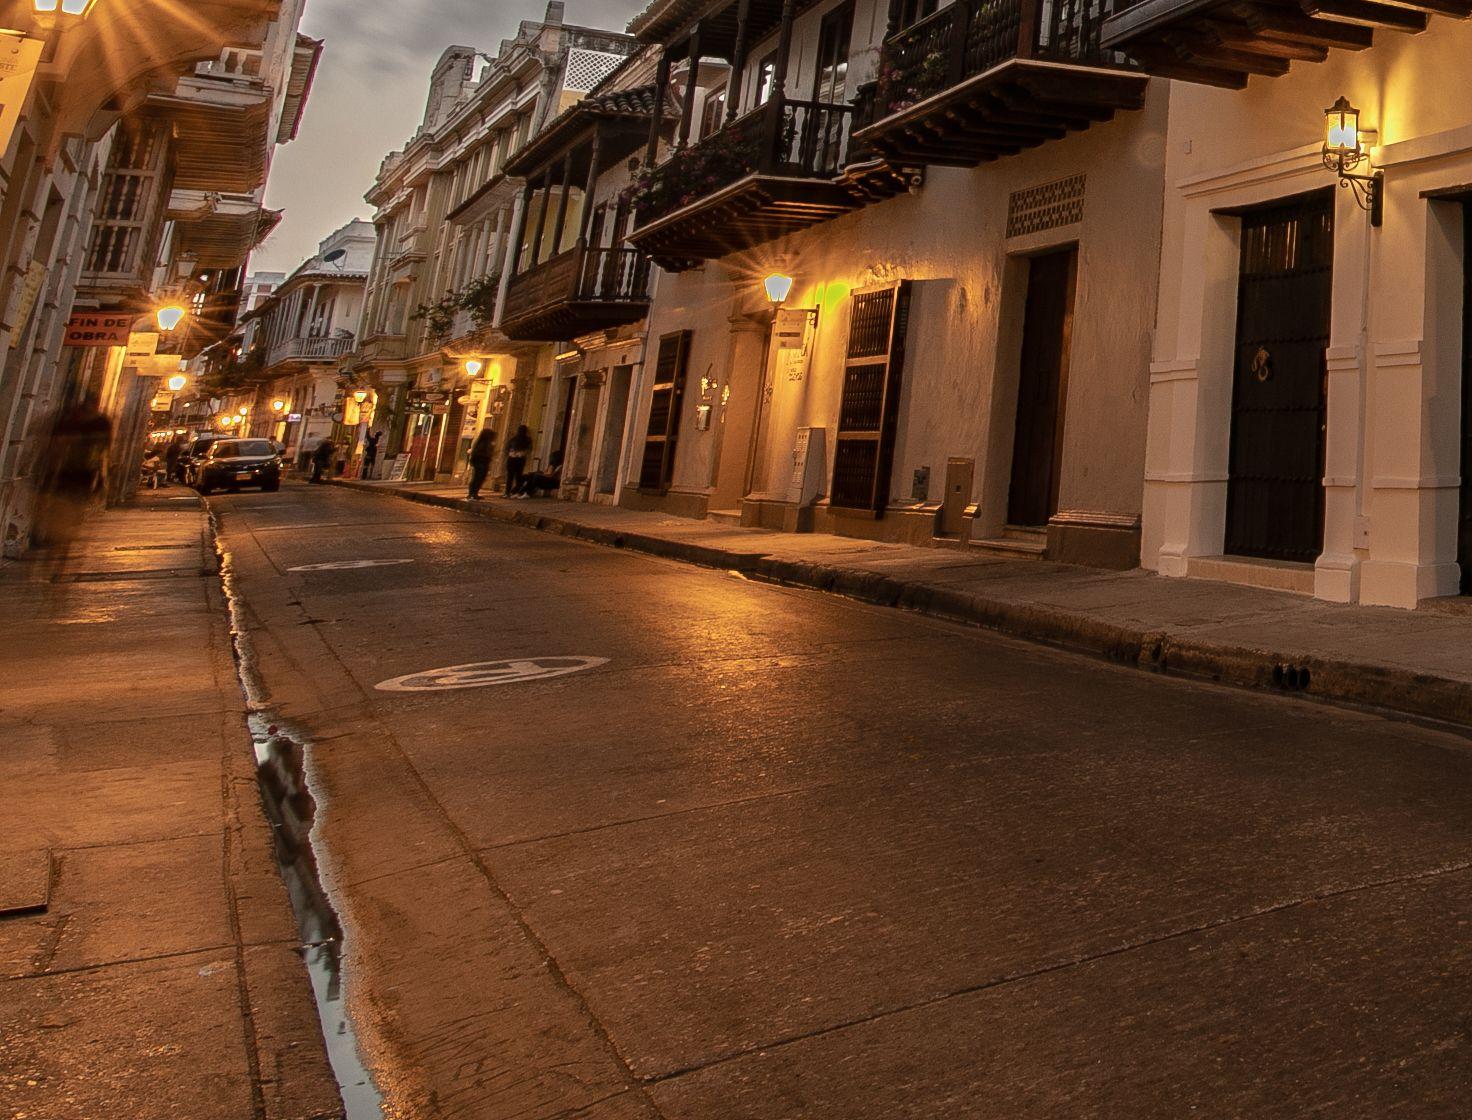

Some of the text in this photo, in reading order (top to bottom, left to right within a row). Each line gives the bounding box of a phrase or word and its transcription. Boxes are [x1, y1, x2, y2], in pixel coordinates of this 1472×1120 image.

[69, 318, 127, 328] FIN DE
[69, 331, 118, 341] OBRA
